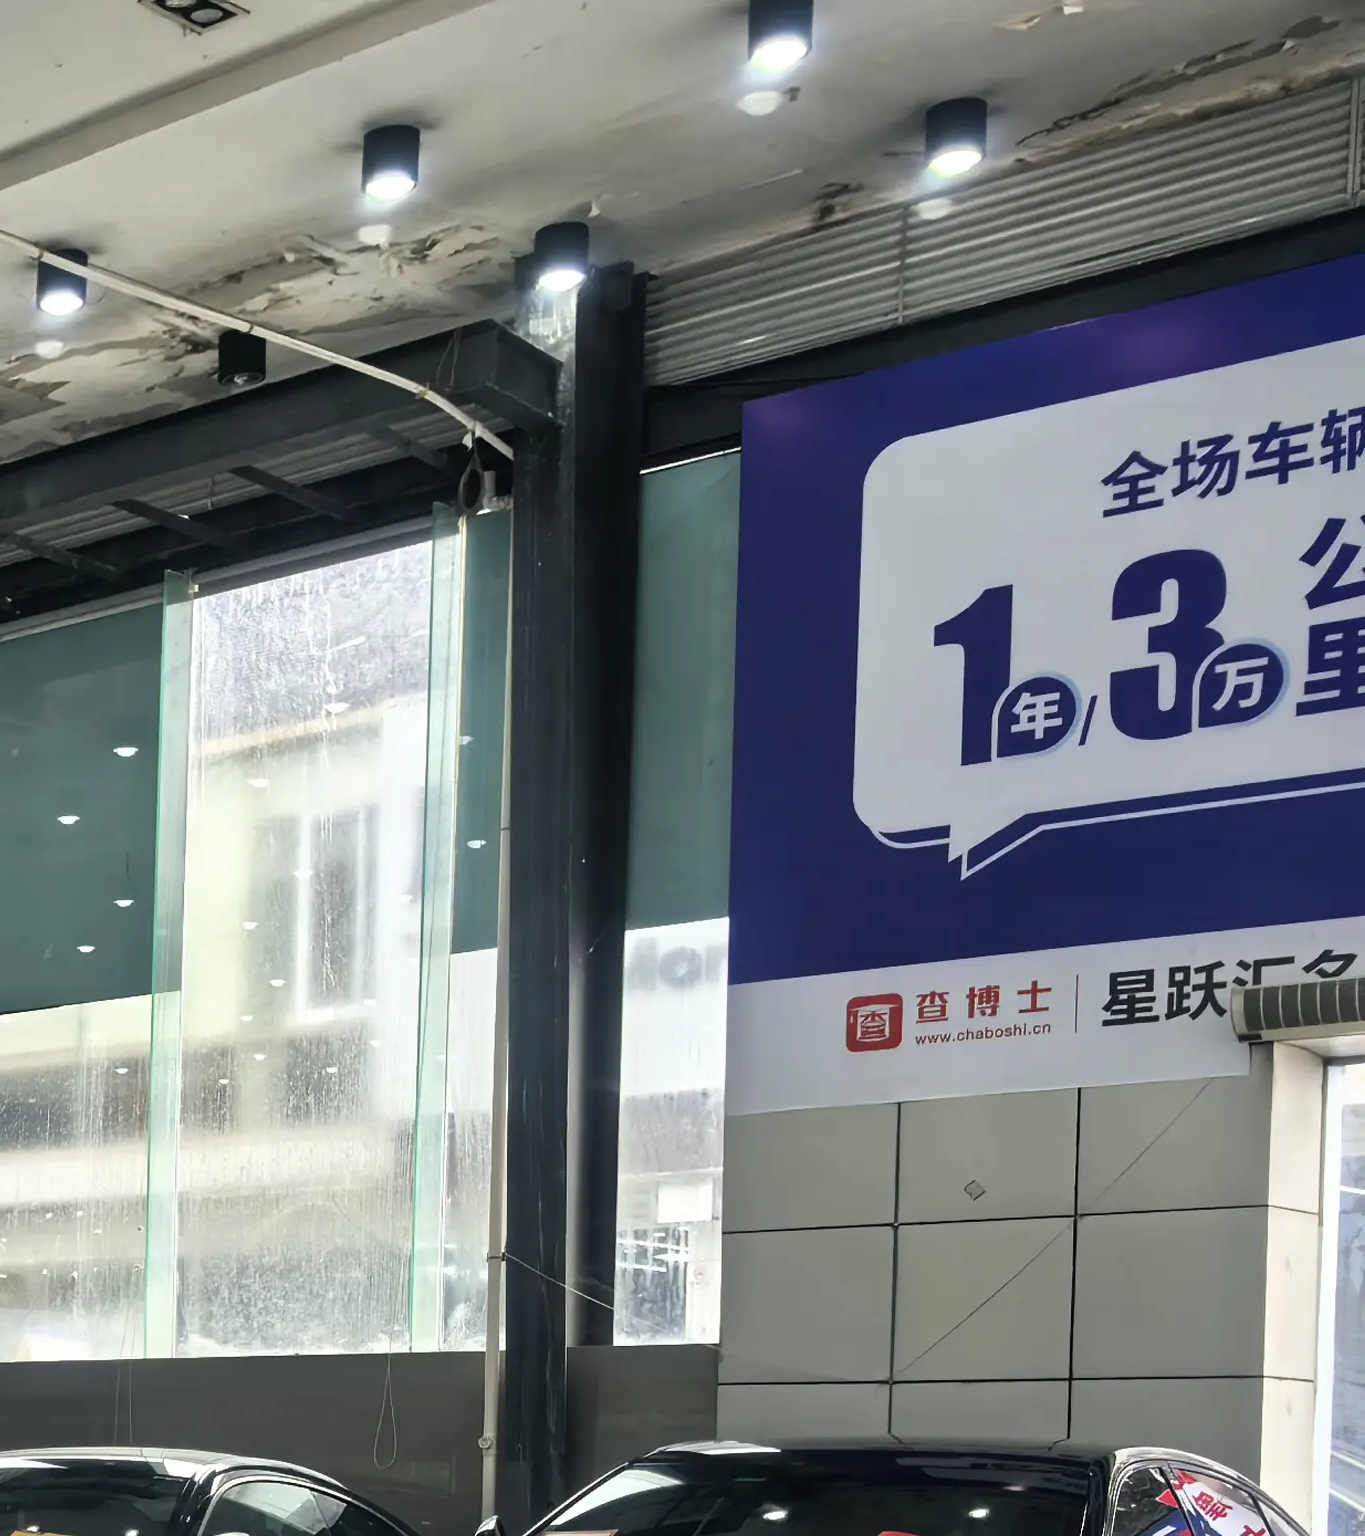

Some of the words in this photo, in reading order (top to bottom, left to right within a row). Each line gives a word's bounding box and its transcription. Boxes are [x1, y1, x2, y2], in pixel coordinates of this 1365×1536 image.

[1100, 405, 1365, 518] 全场车辆
[915, 980, 1053, 1024] 查博士
[915, 1021, 1052, 1046] www.chaboshi.cn
